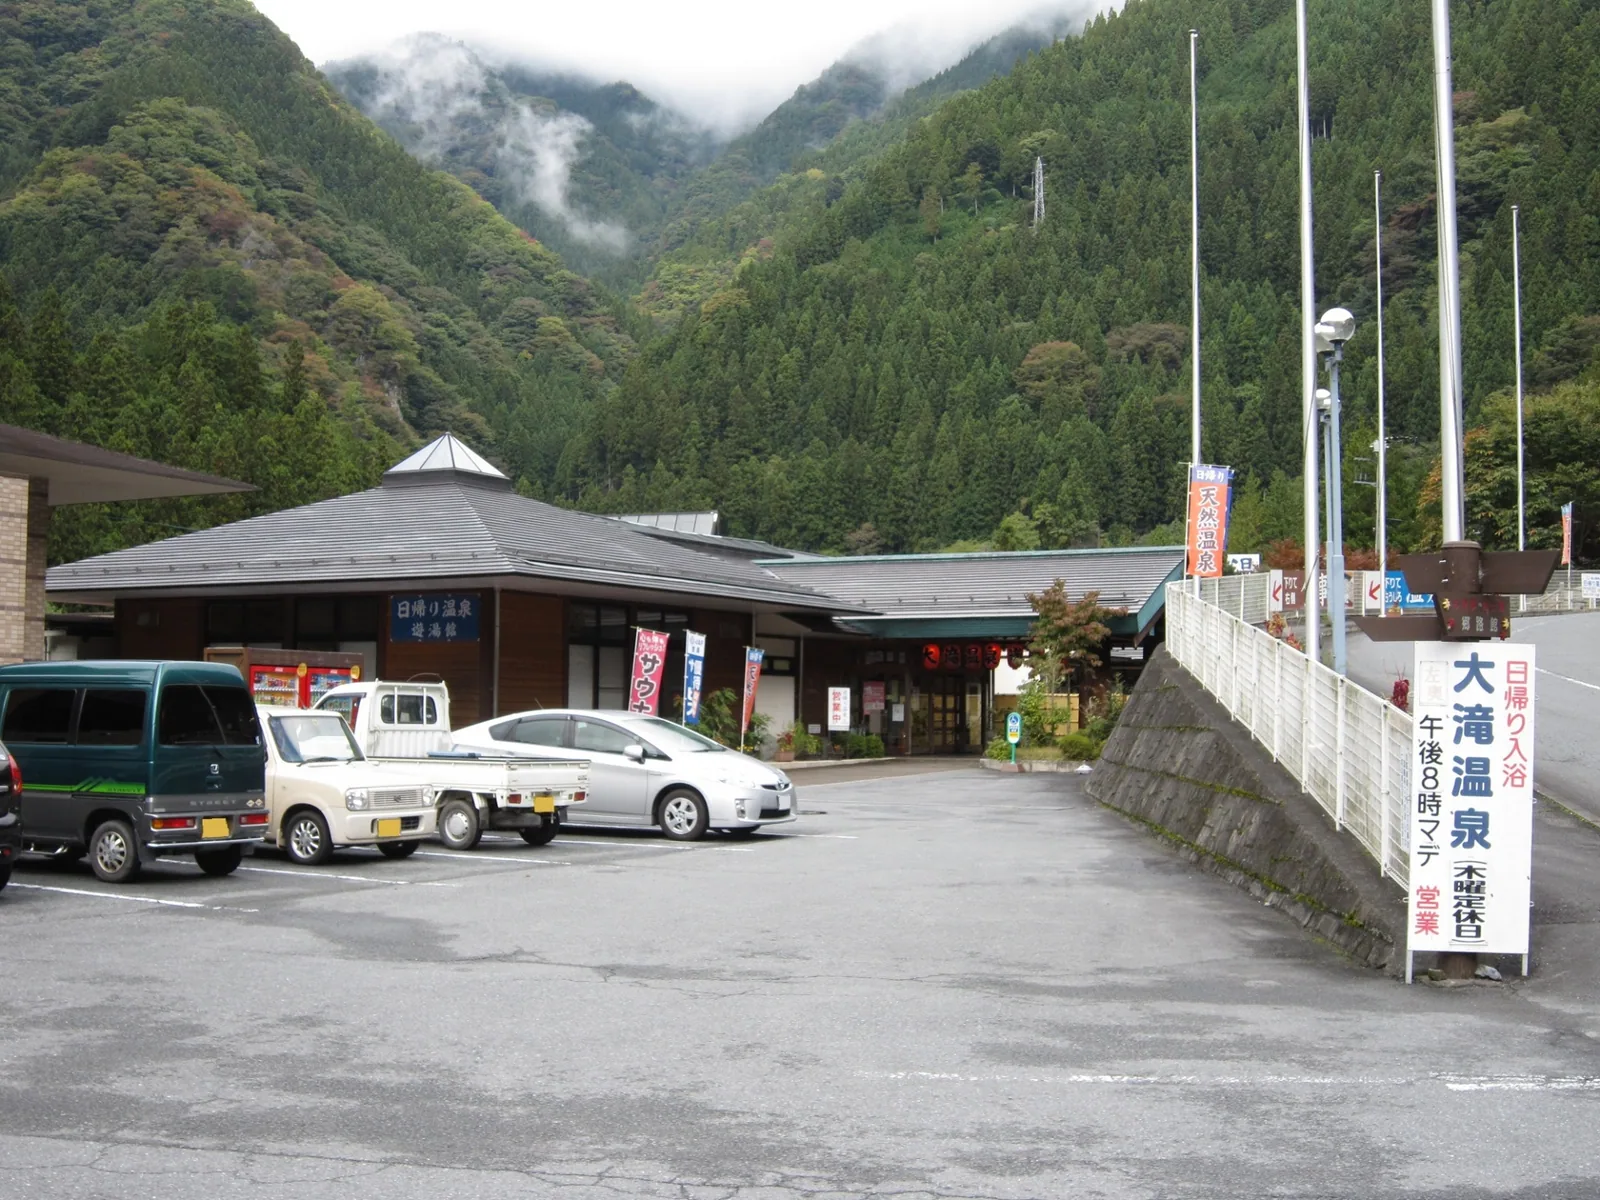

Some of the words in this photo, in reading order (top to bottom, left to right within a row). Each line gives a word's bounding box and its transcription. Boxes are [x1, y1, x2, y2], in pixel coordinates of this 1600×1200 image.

[1196, 469, 1225, 483] 日帰り
[1196, 487, 1219, 573] 天然温泉
[1284, 576, 1298, 590] 下りて
[397, 598, 472, 619] 日帰り温泉
[411, 621, 457, 639] 遊湯館
[633, 652, 661, 714] サウナ
[832, 691, 841, 723] 営業中
[1502, 660, 1528, 788] 日帰り入浴
[1450, 652, 1496, 850] 大滝温泉
[189, 799, 237, 807] STREET
[1417, 714, 1444, 867] 午後8時マデ
[1414, 884, 1441, 936] 営業
